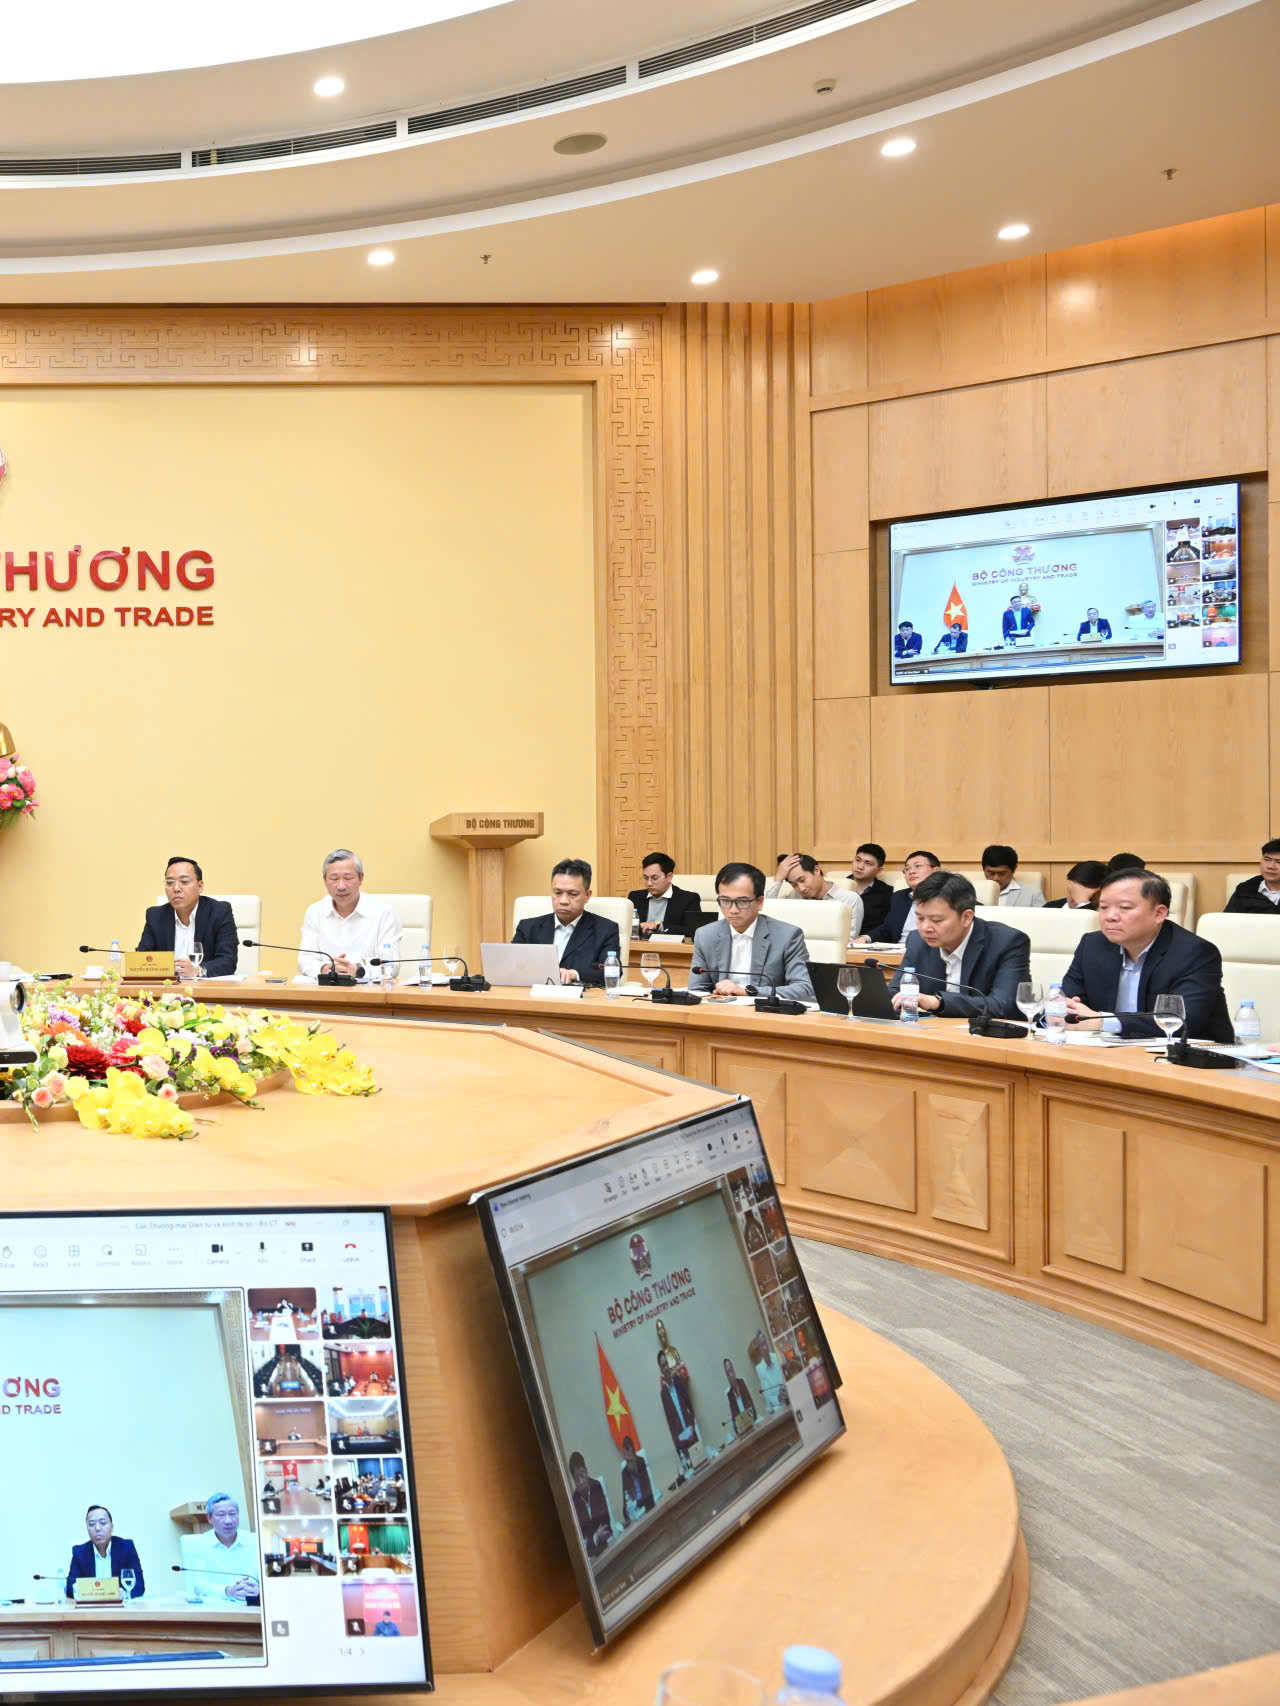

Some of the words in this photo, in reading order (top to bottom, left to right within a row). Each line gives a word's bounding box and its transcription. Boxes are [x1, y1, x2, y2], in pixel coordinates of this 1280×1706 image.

[43, 607, 106, 628] AND
[113, 606, 215, 627] TRADE
[15, 1404, 62, 1414] TRADE
